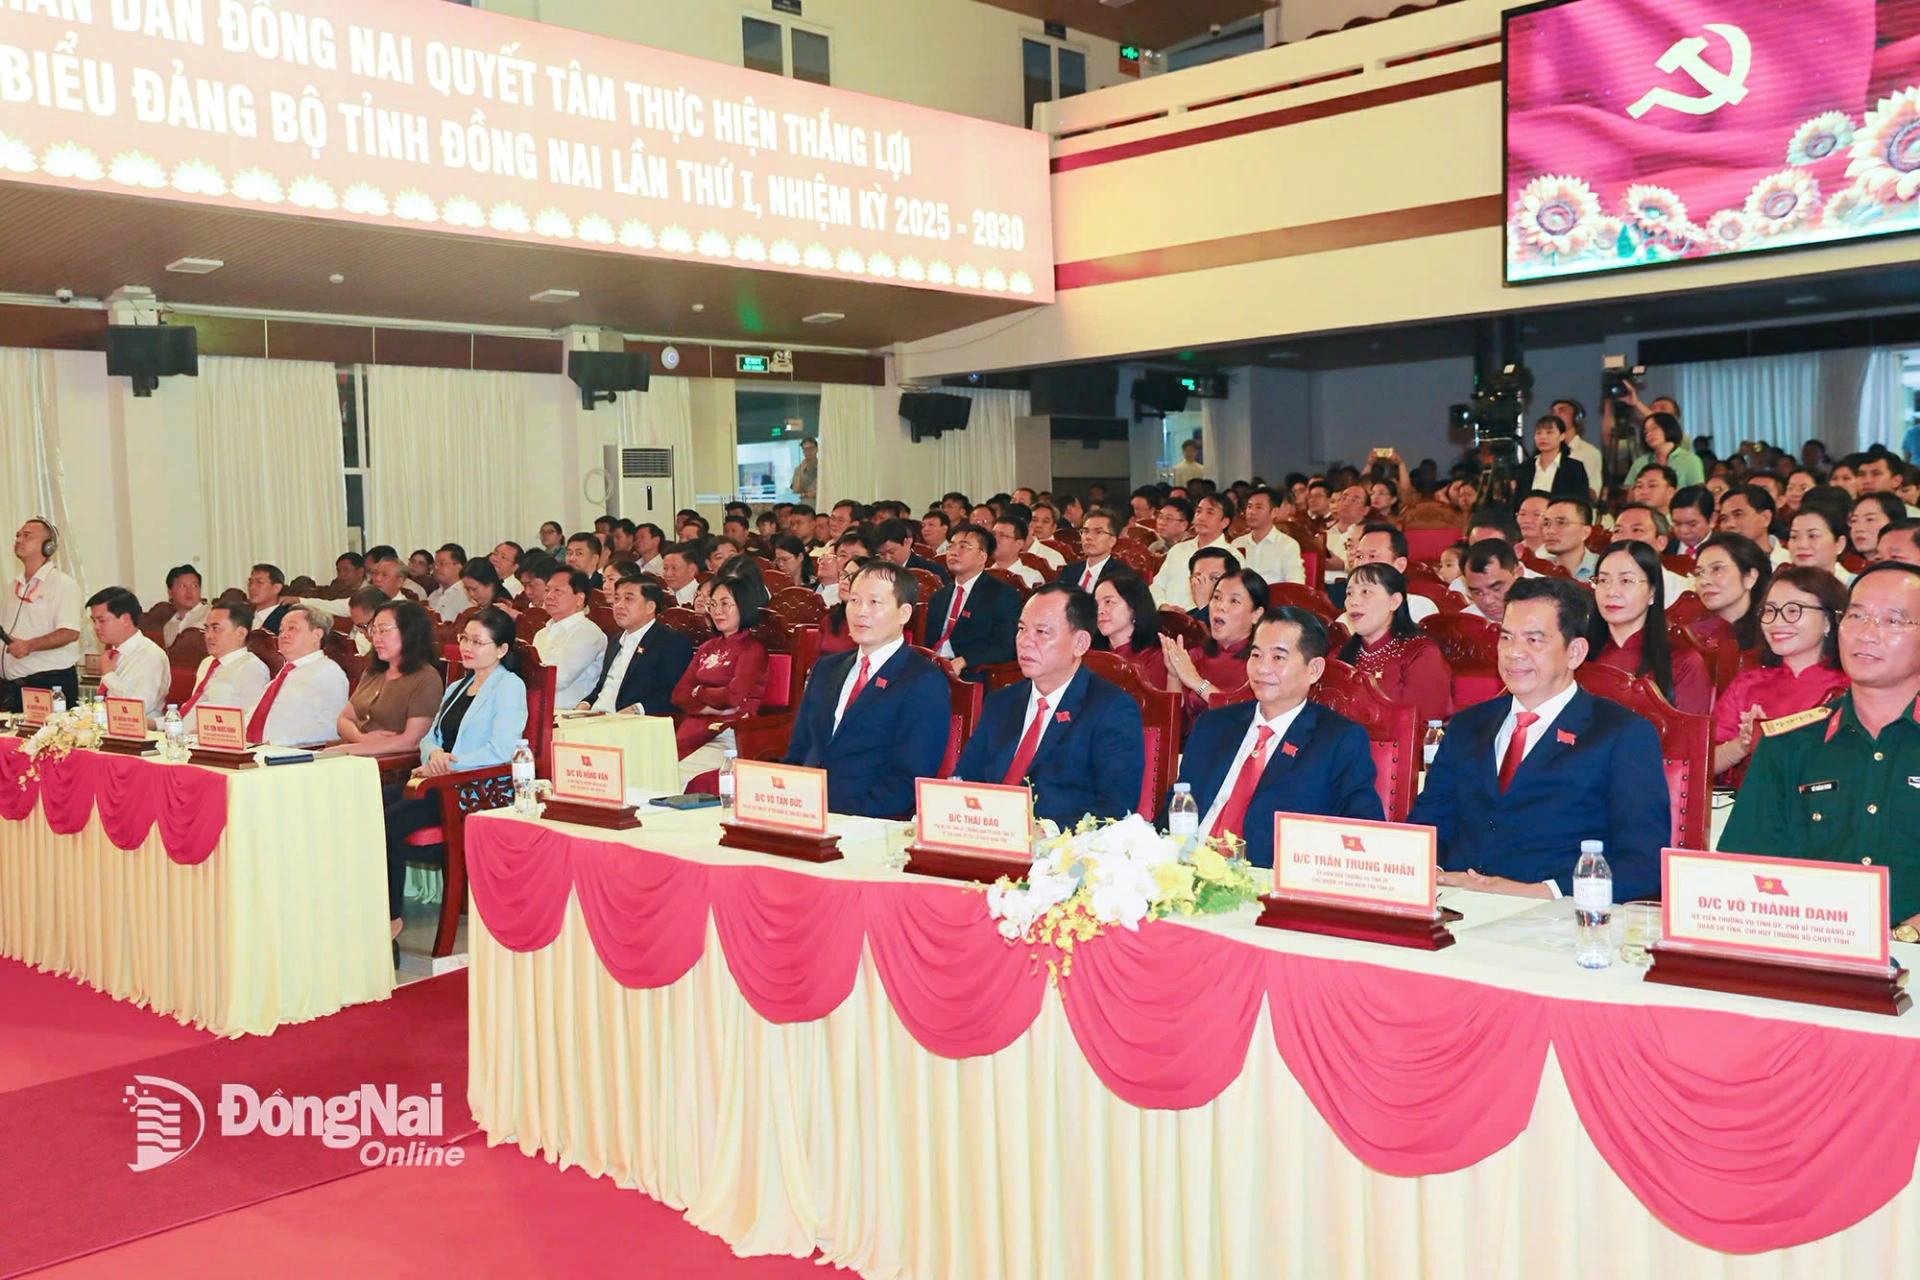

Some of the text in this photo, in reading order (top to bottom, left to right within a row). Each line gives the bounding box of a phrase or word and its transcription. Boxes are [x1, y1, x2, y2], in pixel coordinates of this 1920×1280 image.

[217, 0, 337, 70] ĐỒNG
[349, 26, 414, 85] NAI
[426, 42, 537, 106] QUYẾT
[546, 60, 616, 121] TÂM
[624, 82, 704, 143] THỰC
[713, 96, 777, 156] HIỆN
[783, 107, 868, 166] THẮNG
[874, 130, 911, 175] LỢI
[0, 32, 116, 116] BIỂU
[131, 60, 257, 138] ĐẢNG
[271, 84, 327, 159] BỘ
[338, 91, 430, 164] TỈNH
[440, 108, 538, 180] ĐỒNG
[548, 139, 602, 190] NAI
[612, 137, 669, 199] LẦN
[676, 157, 734, 208] THỨ
[768, 173, 851, 231] NHIỆM
[859, 183, 887, 231] KỲ
[895, 197, 951, 240] 2025
[973, 209, 1025, 251] 2030
[1293, 852, 1310, 864] Đ/C
[1345, 858, 1380, 872] TRUNG
[1698, 896, 1849, 923] Đ/C VÕ THÀNH DANH
